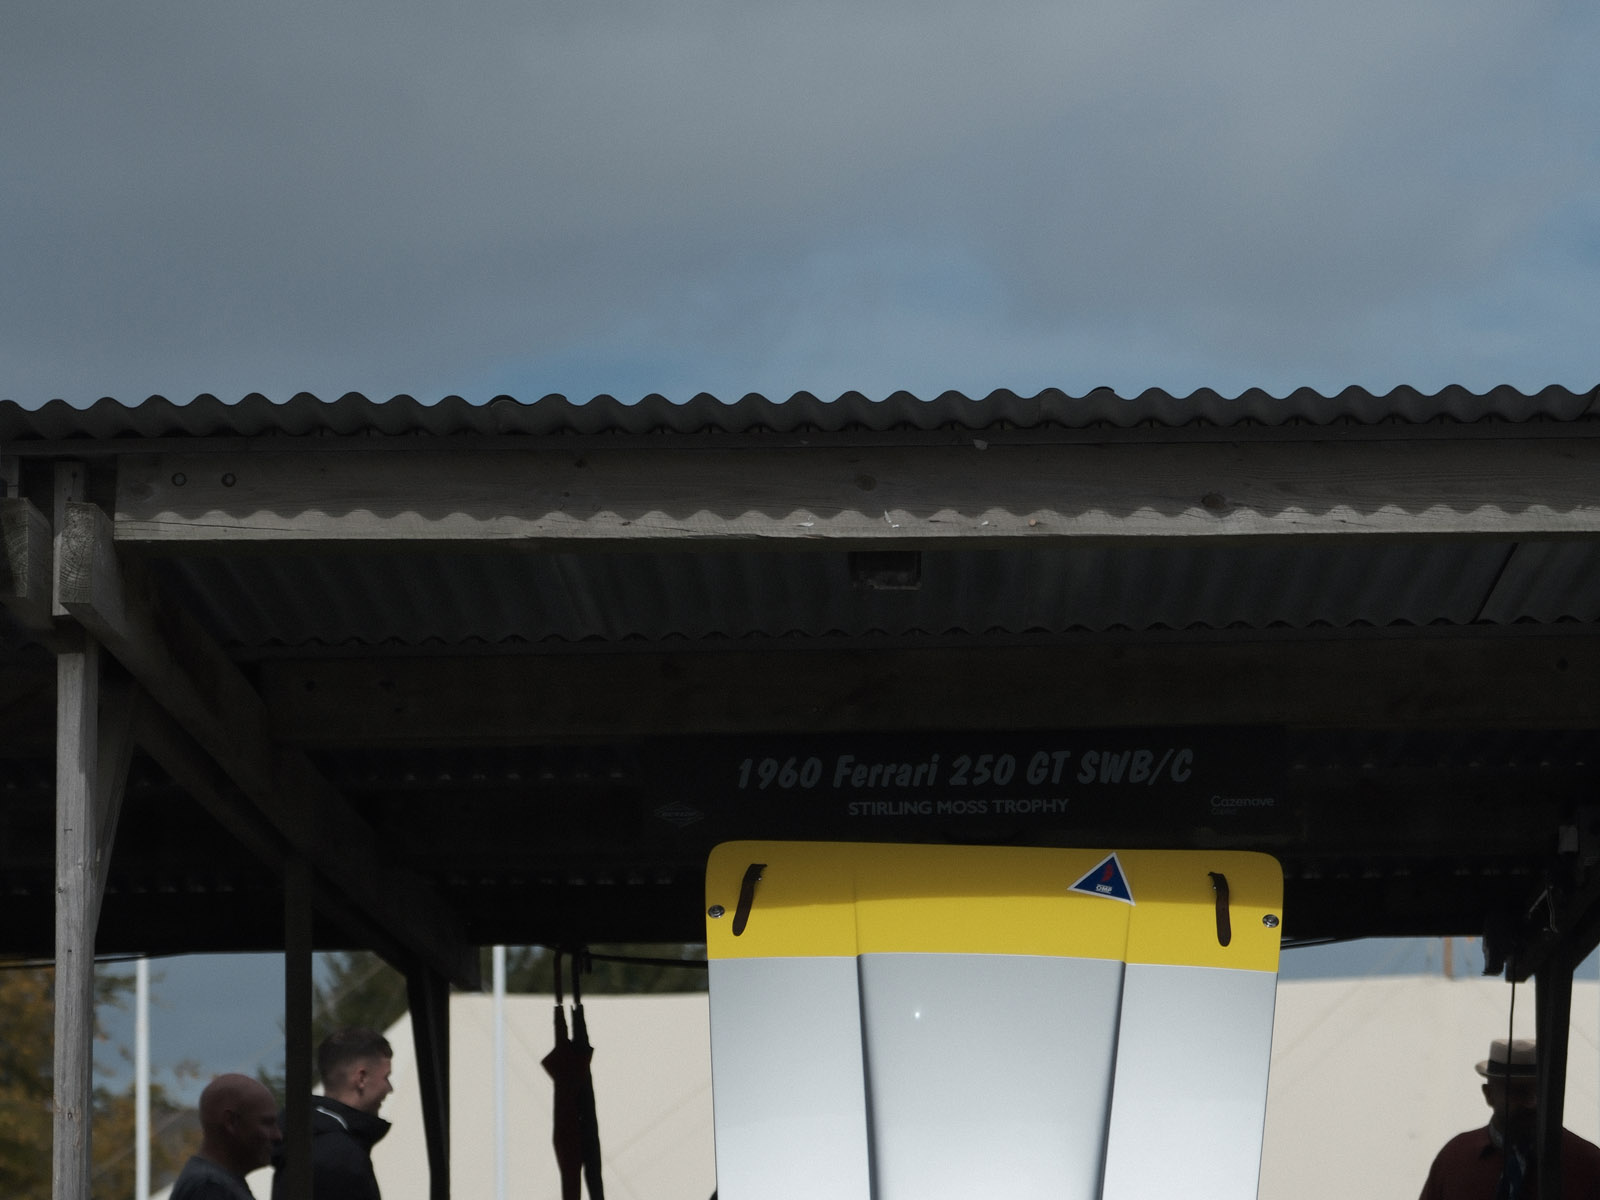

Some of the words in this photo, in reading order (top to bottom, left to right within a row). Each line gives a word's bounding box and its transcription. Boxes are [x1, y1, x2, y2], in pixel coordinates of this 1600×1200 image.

[738, 756, 823, 790] 1960
[833, 753, 940, 788] Ferrari
[949, 753, 1017, 786] 250
[1026, 751, 1071, 785] GT
[1077, 748, 1193, 785] SWB/C
[848, 801, 932, 816] STIRLING
[937, 800, 988, 815] MOSS
[992, 799, 1069, 815] TROPHY
[1210, 795, 1274, 807] Cazenove
